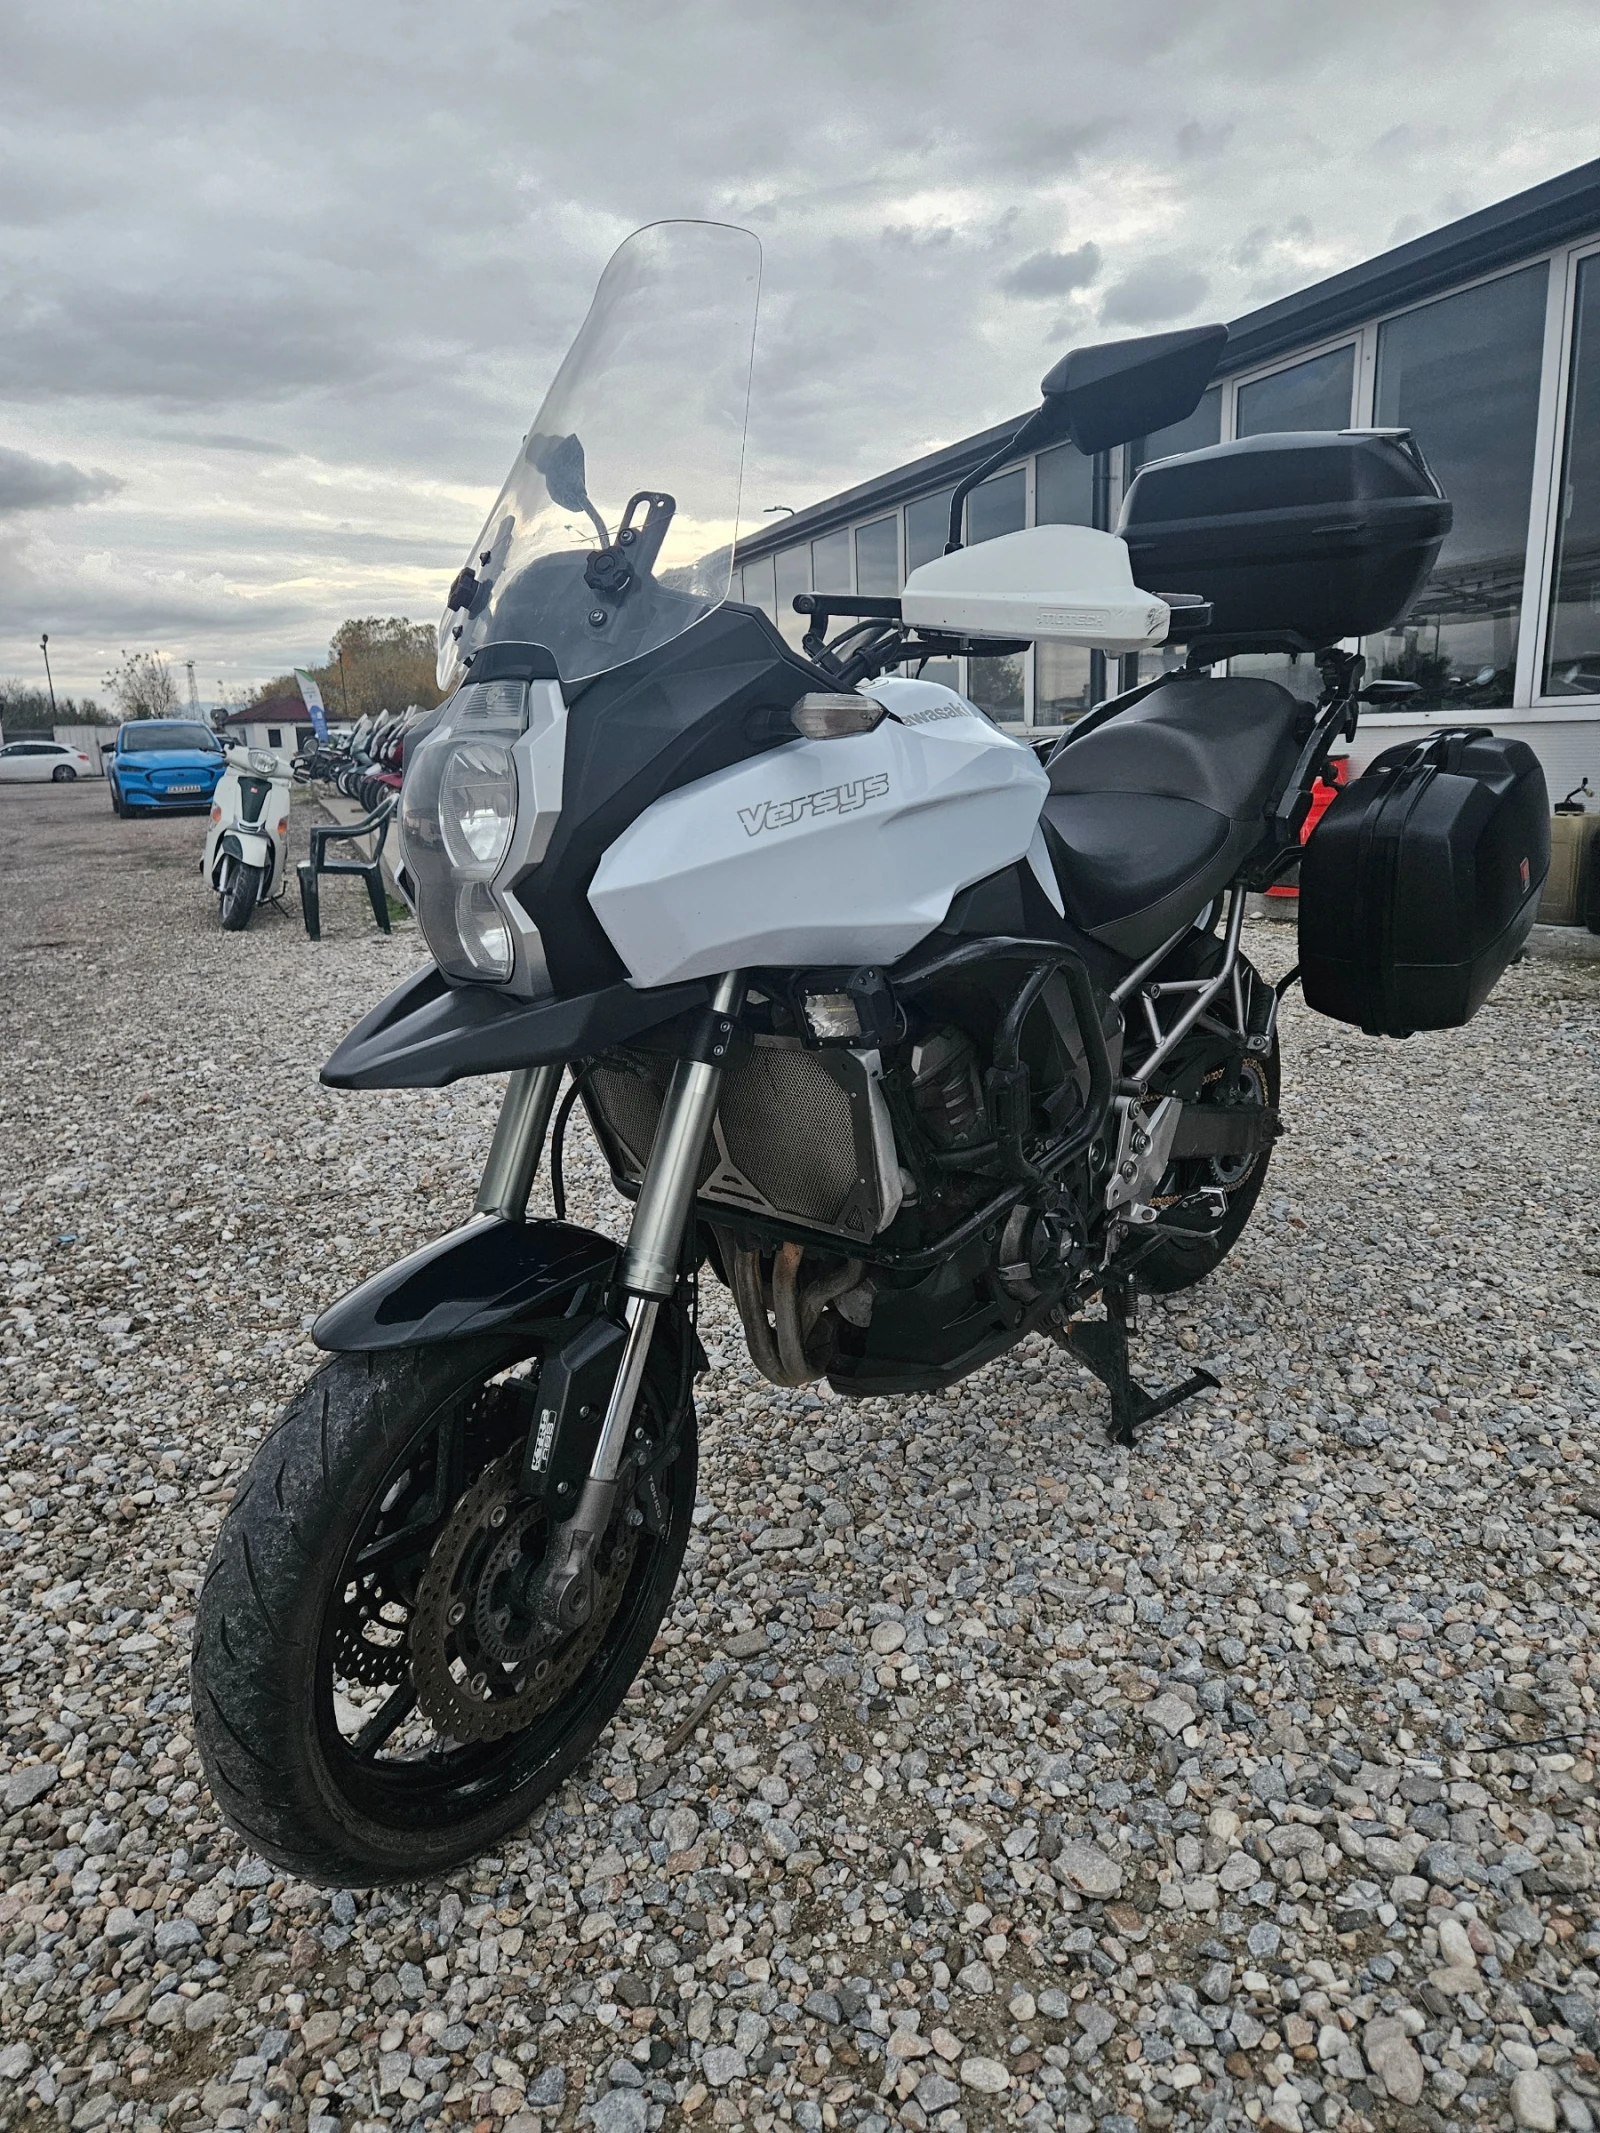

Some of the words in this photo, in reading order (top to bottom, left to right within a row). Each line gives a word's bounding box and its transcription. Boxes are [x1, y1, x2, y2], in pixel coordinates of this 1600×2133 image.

[901, 702, 973, 727] awasaki
[736, 772, 890, 838] Versys
[648, 1474, 662, 1519] TOKICO
